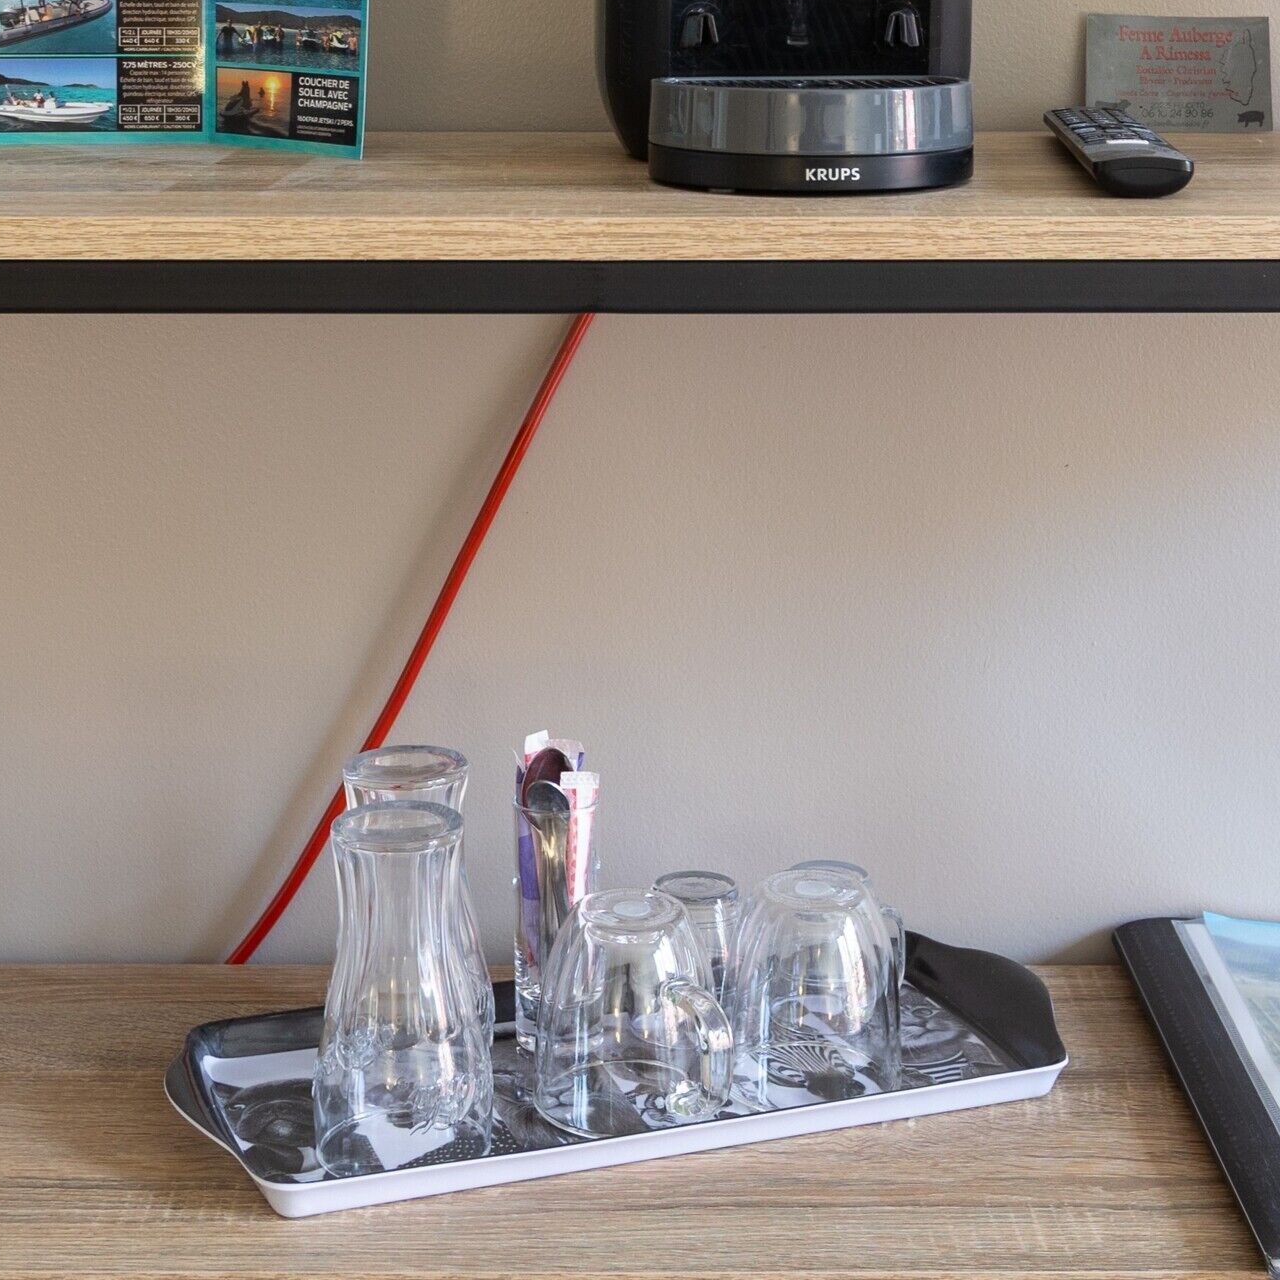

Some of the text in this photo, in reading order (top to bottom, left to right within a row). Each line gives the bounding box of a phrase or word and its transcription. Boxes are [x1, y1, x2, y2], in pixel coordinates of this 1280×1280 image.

[1119, 24, 1233, 48] Ferme Auberge
[299, 77, 350, 89] COUCHER DE
[299, 88, 348, 100] SOLEIL AVEC
[805, 168, 861, 182] KRUPS
